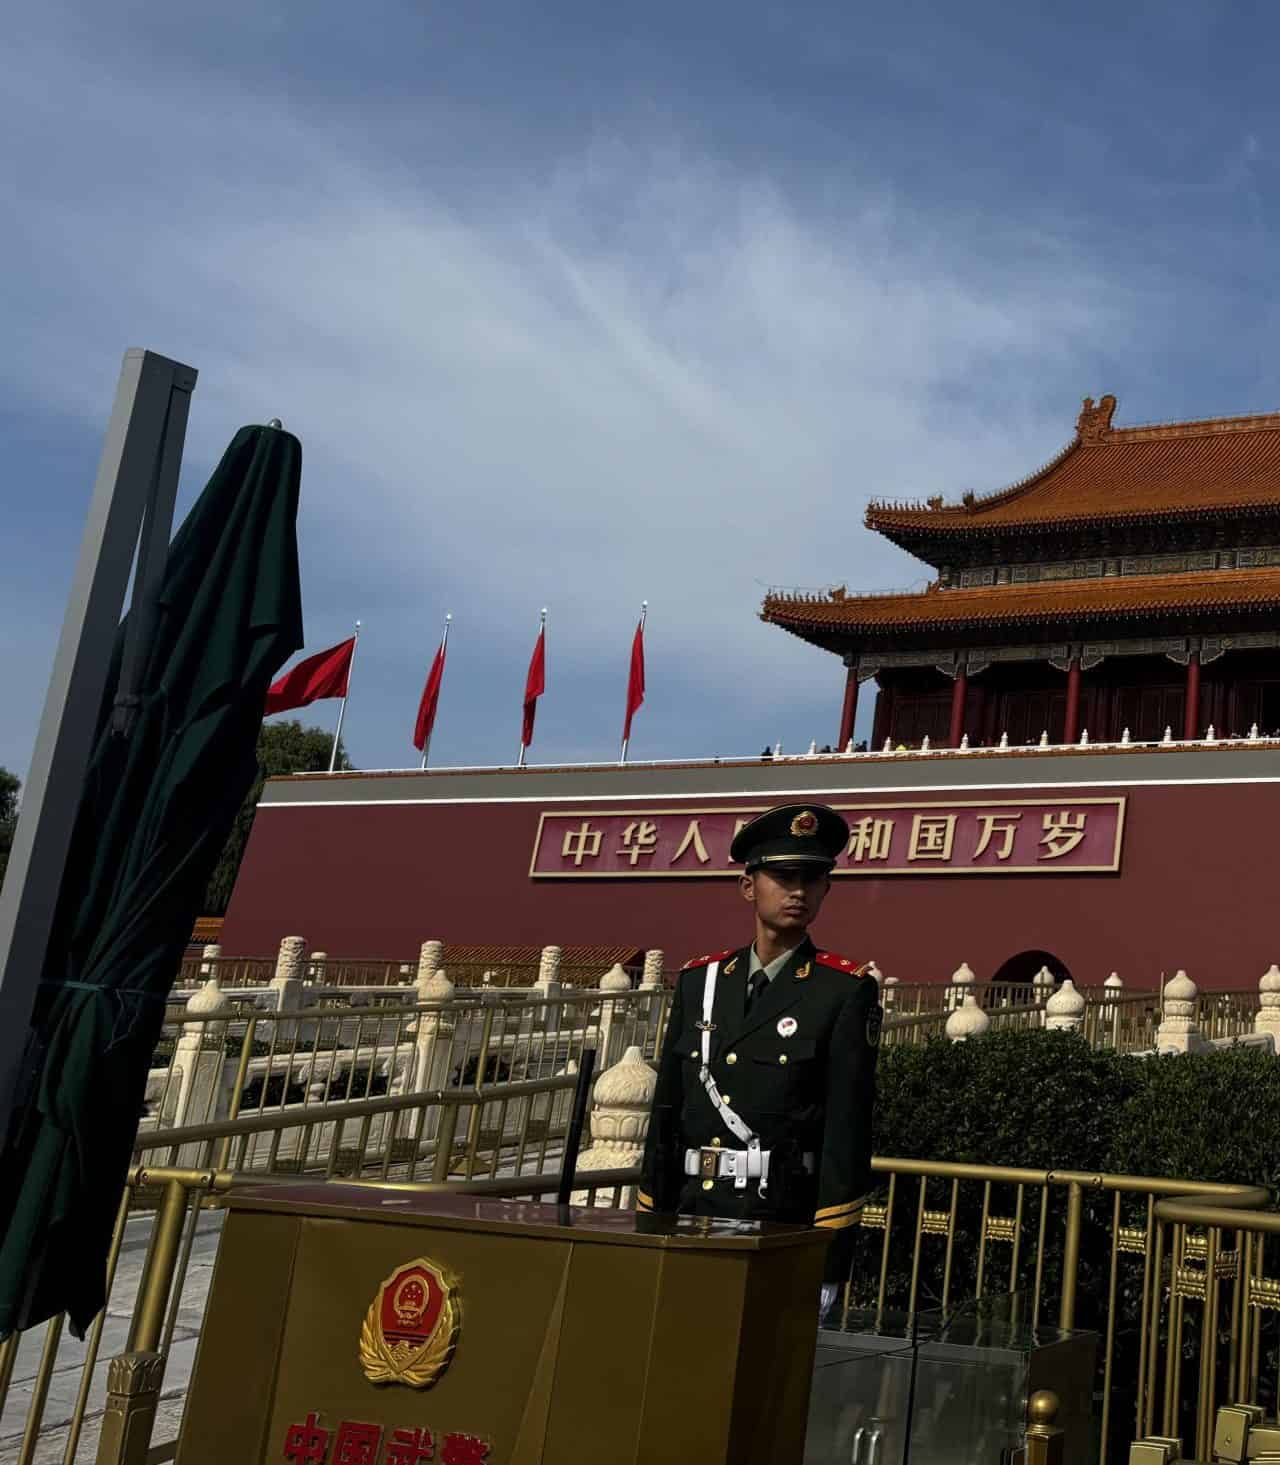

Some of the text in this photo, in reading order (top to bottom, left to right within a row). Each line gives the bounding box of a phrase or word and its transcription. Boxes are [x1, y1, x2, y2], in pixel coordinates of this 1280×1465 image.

[561, 811, 1087, 865] 中华人和国万岁
